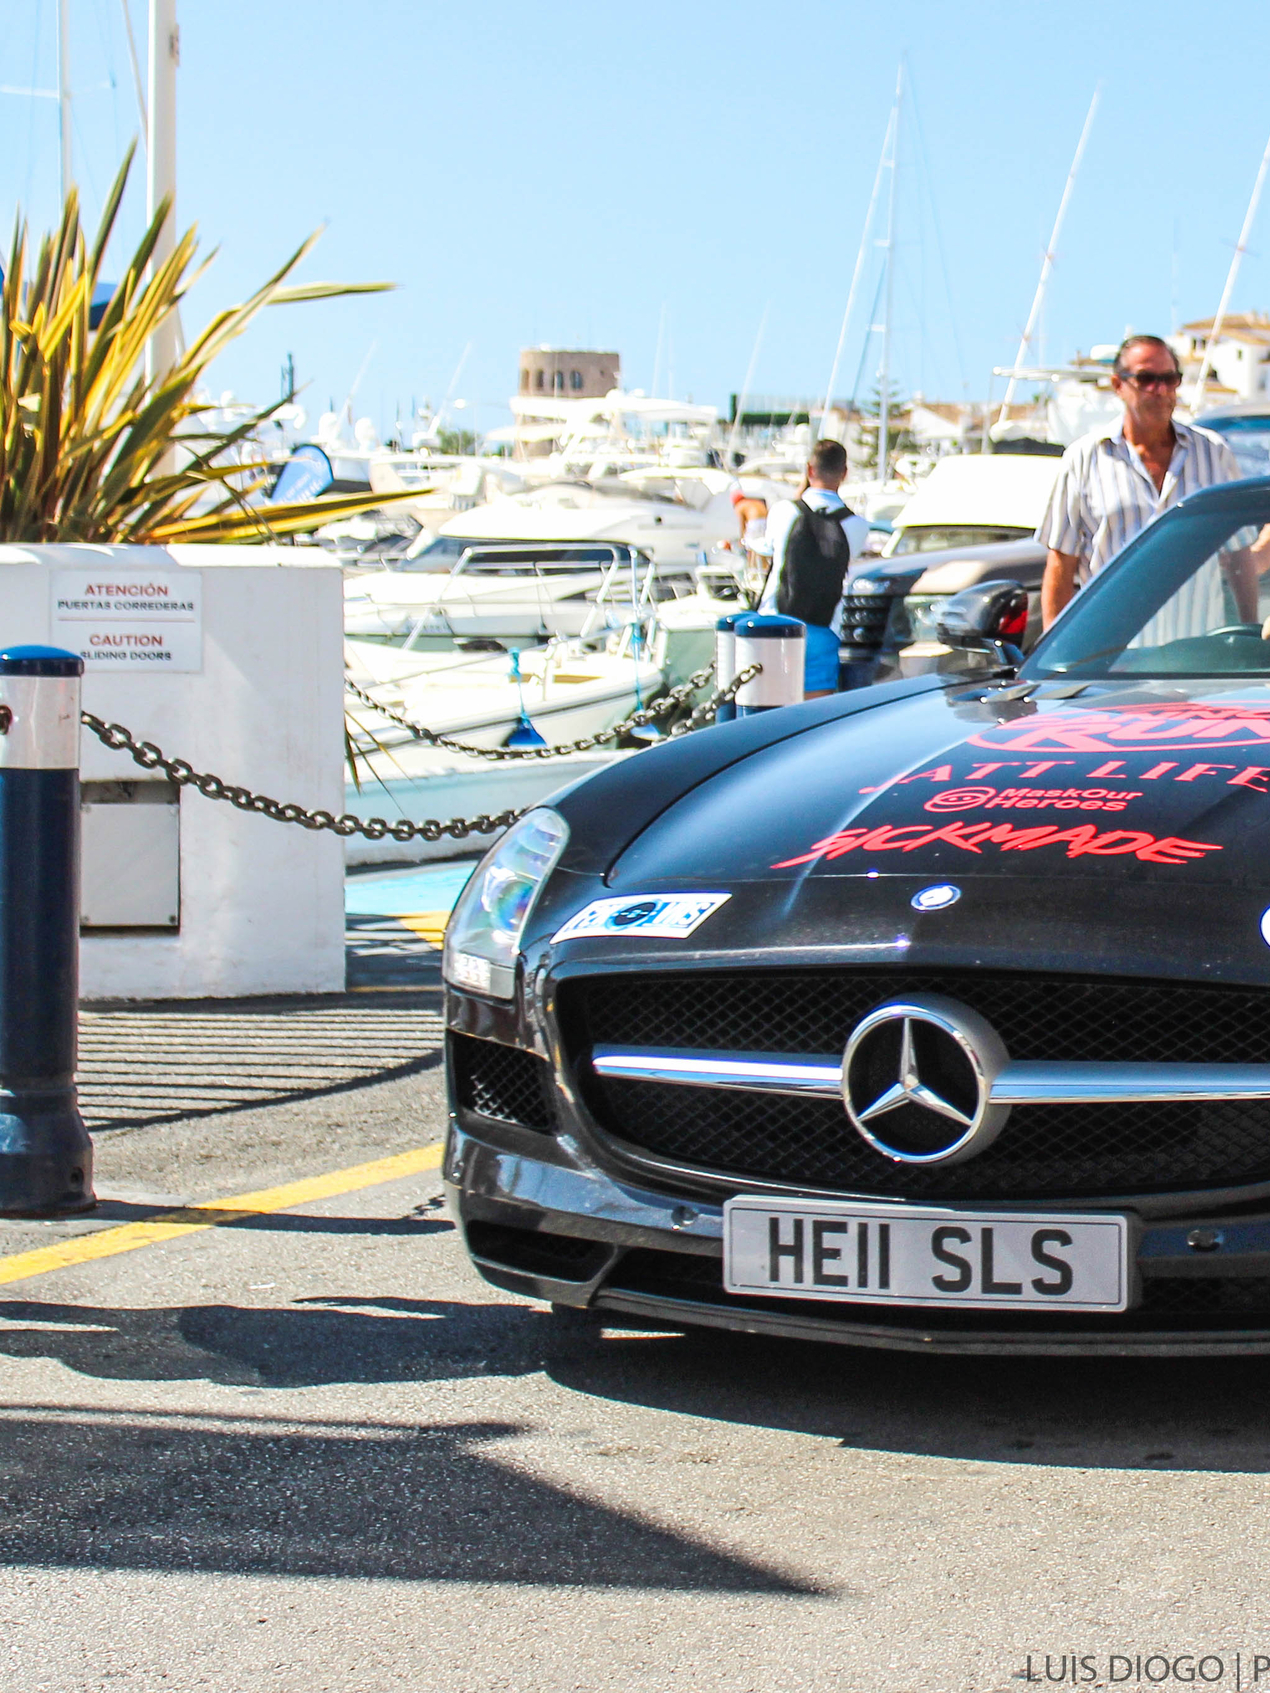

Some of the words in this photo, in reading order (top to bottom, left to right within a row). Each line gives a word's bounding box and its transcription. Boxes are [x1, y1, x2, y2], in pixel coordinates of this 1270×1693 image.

[84, 583, 169, 597] ATENCIÓN
[57, 600, 112, 611] PUERTAS
[114, 601, 195, 612] CORREDERAS
[89, 634, 164, 647] CAUTION
[80, 651, 128, 661] SLIDING
[130, 651, 173, 661] DOORS
[999, 787, 1144, 801] MaskOur
[984, 796, 1129, 812] Heroes
[769, 820, 1225, 865] SICKMADE
[931, 1225, 1074, 1297] SLS
